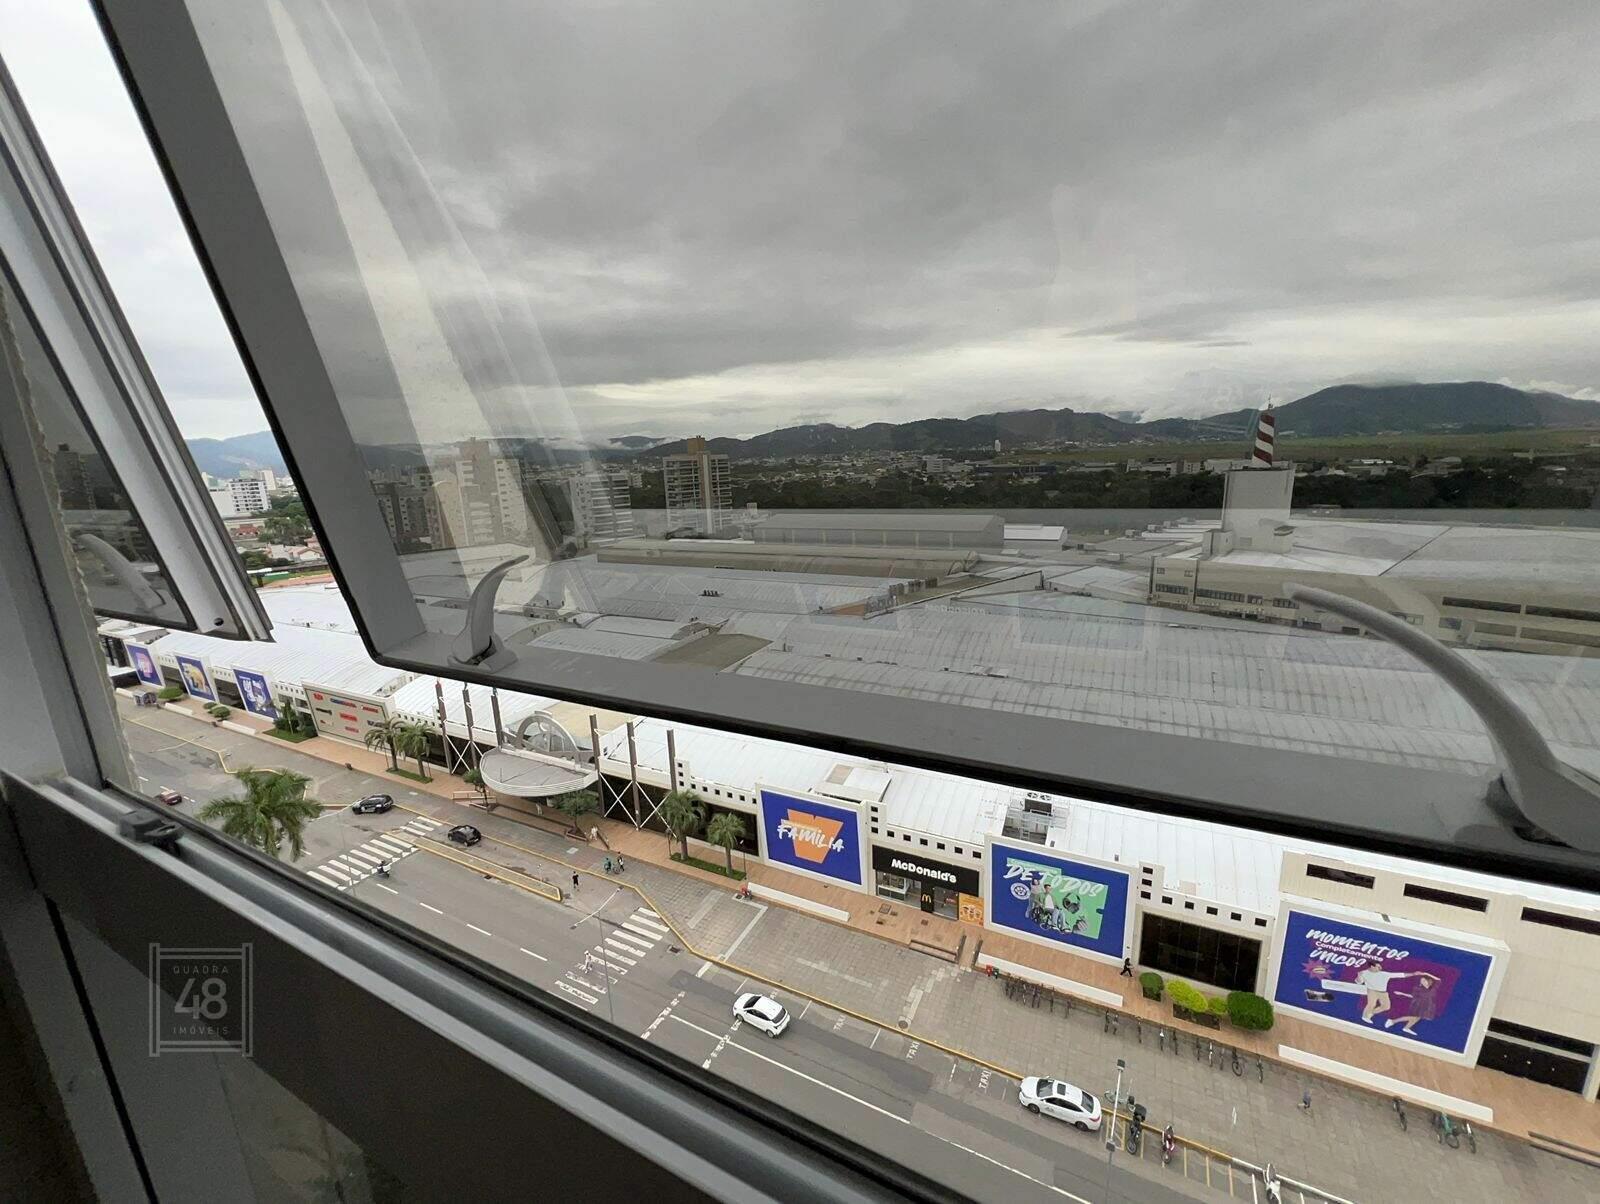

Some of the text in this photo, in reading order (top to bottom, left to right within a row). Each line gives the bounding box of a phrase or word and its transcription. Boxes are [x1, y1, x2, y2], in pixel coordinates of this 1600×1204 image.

[891, 858, 958, 884] McDonald's
[1305, 928, 1410, 961] MOMENTOS
[905, 1040, 921, 1060] TAXI
[978, 1069, 993, 1089] TAXI
